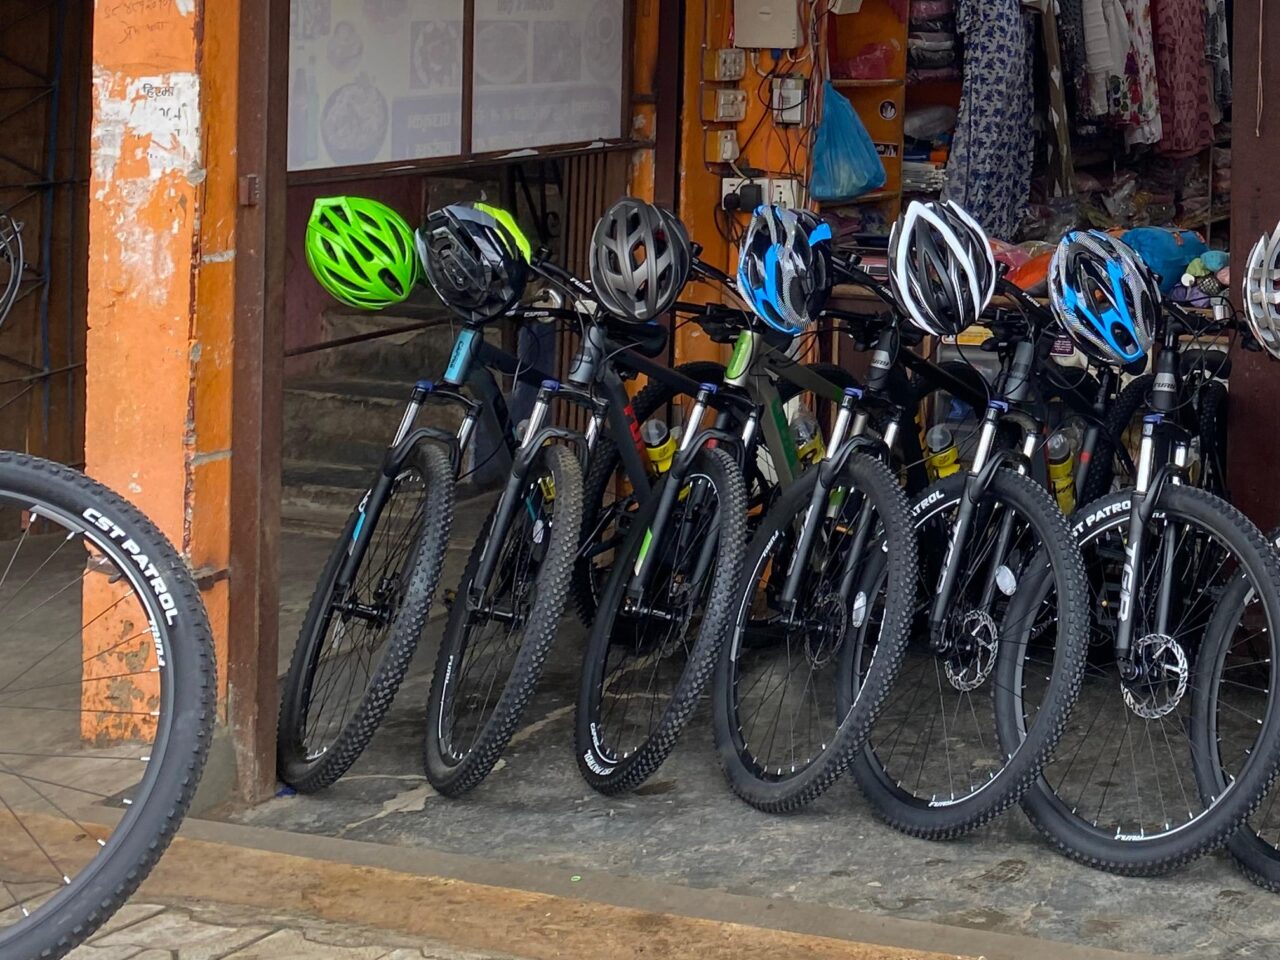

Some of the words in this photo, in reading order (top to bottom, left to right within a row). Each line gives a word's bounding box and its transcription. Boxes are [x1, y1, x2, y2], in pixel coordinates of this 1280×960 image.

[912, 490, 945, 516] TROL
[1085, 500, 1132, 527] PATRO
[82, 507, 126, 540] CST
[121, 538, 178, 626] PATROL
